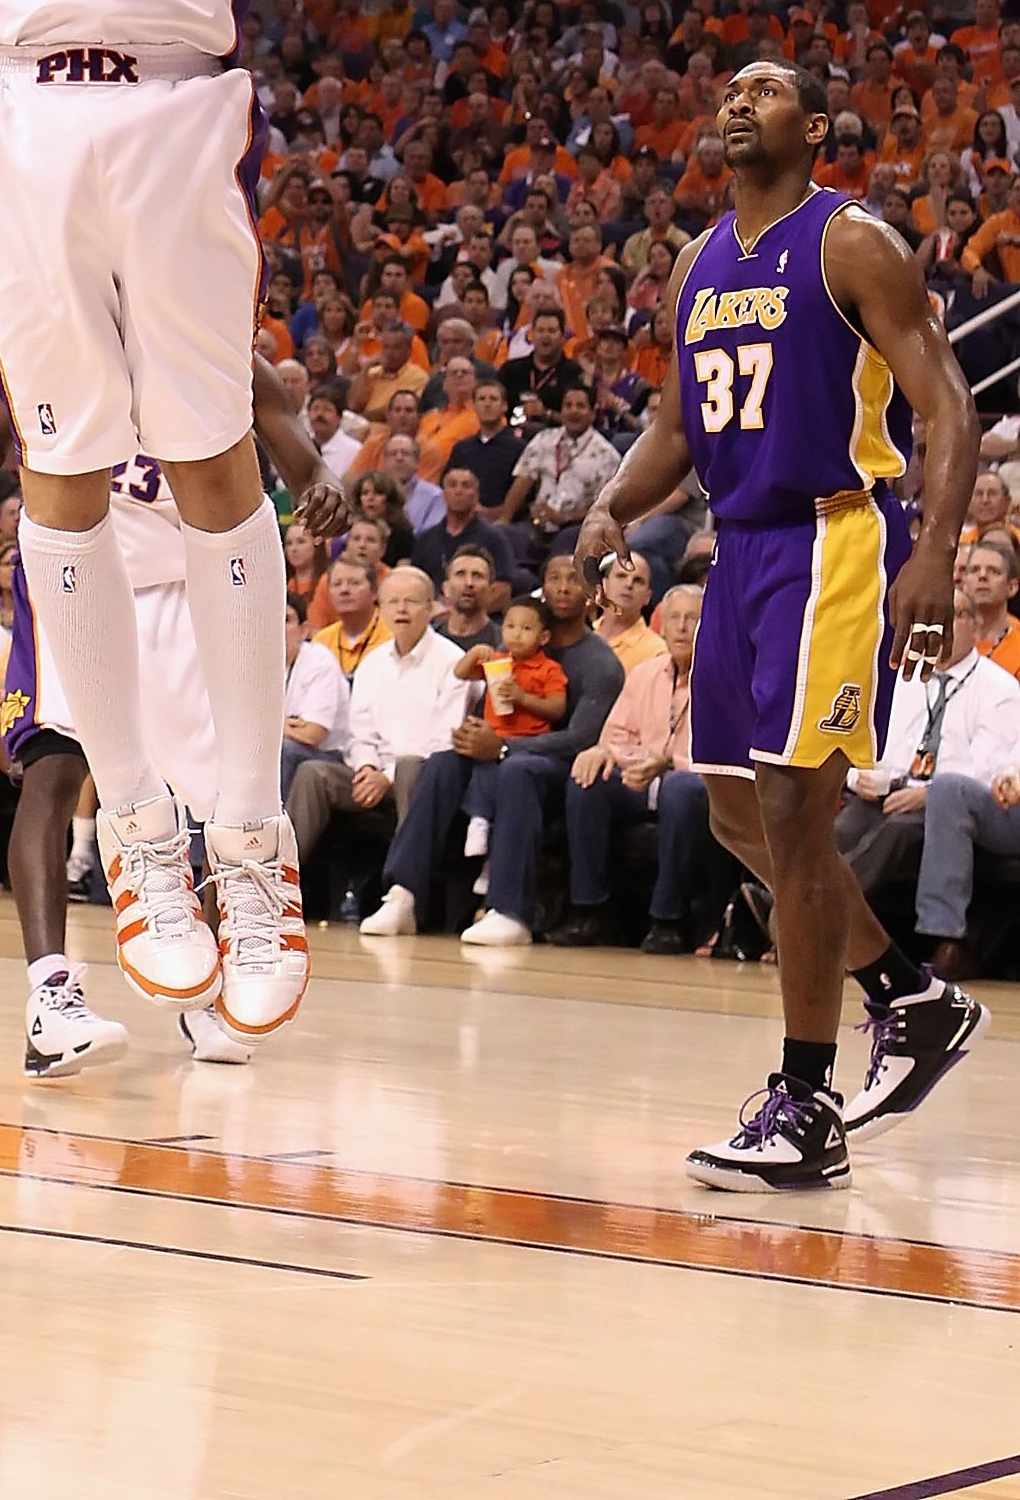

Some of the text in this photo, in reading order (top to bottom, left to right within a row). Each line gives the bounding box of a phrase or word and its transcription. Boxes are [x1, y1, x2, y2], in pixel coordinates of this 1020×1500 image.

[35, 47, 139, 85] PHX
[685, 286, 790, 345] LAKERS
[693, 342, 774, 433] 37
